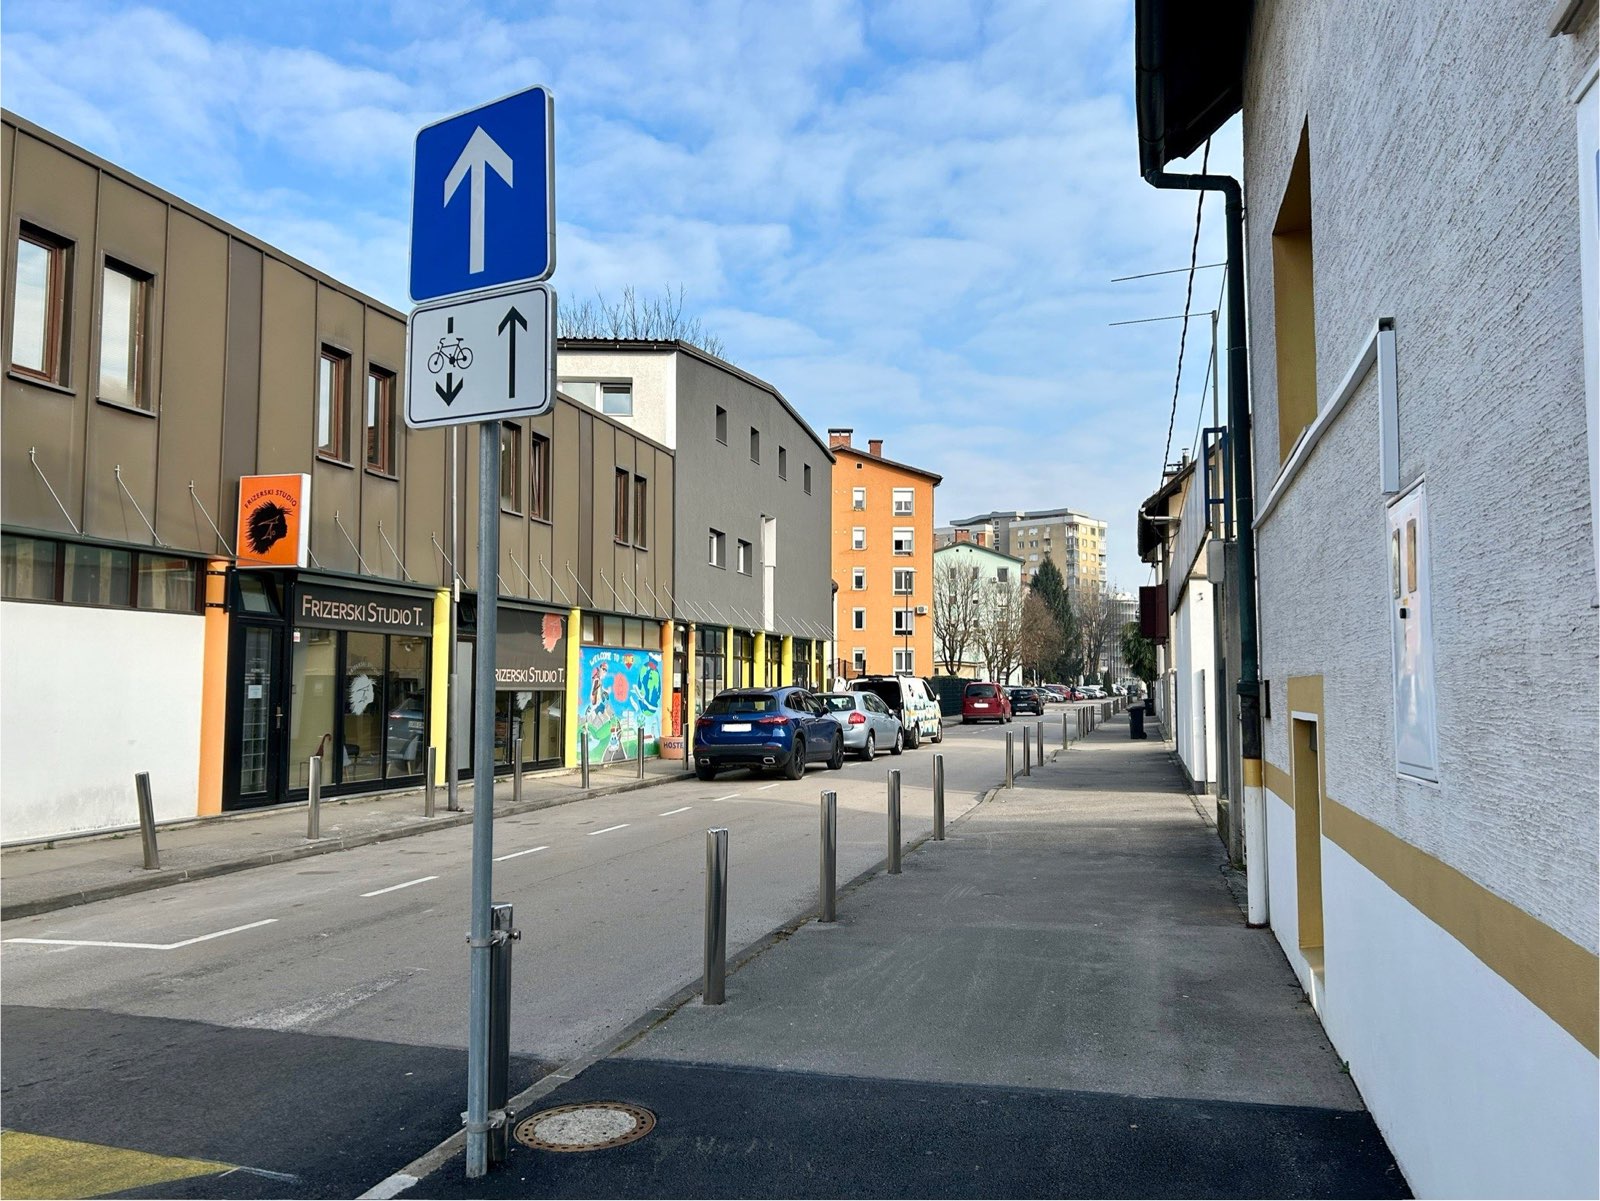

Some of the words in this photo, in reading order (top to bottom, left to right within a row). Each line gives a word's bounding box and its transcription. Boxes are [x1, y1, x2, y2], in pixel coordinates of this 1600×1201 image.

[244, 489, 274, 509] FRIZERSKI
[275, 489, 297, 507] STUDIO
[302, 595, 365, 621] FRIZERSKI
[367, 602, 412, 625] STUDIO
[413, 607, 424, 626] T.
[495, 668, 528, 683] RIZERSKI
[529, 666, 557, 683] STUDIO
[558, 667, 565, 683] T.
[663, 741, 684, 749] HOSTE
